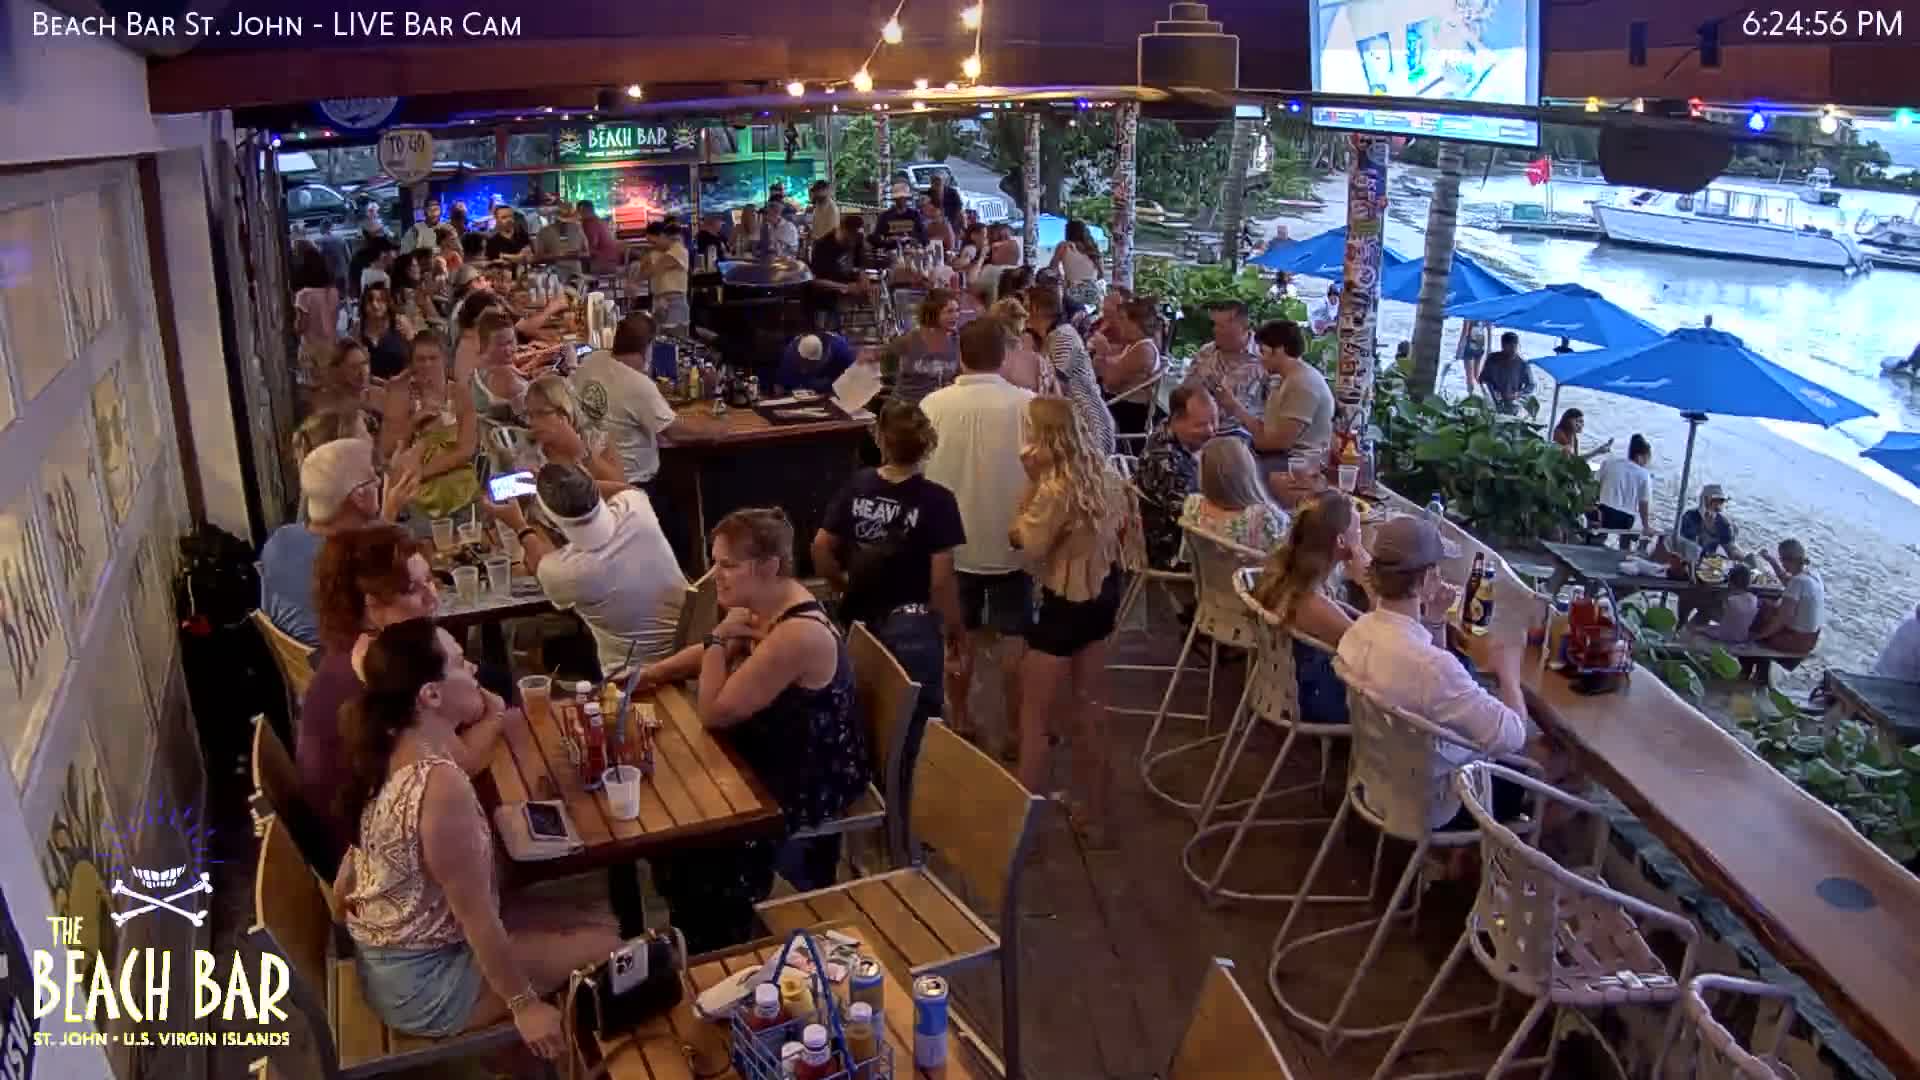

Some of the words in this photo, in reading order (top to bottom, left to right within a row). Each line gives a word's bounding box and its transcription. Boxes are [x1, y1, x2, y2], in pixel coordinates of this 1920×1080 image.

[587, 127, 632, 149] BEACH
[636, 127, 668, 146] BAR
[851, 497, 920, 529] HEAVN
